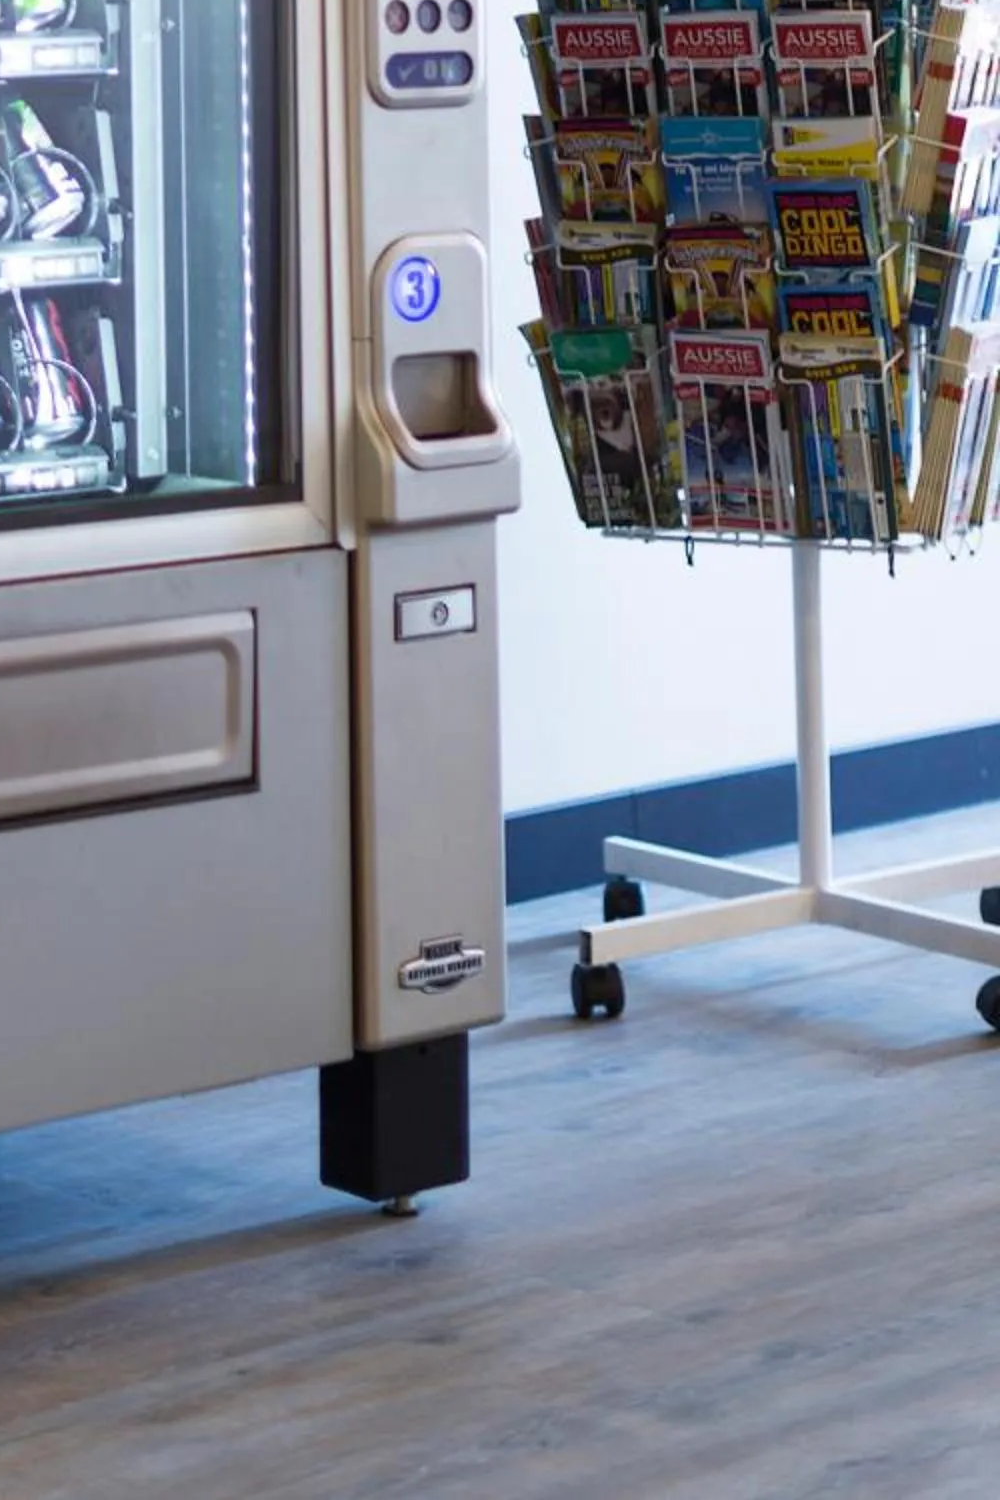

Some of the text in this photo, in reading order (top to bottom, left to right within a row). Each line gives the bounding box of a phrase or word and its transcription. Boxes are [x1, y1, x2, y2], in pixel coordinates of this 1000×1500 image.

[565, 28, 632, 48] AUSSIE
[673, 28, 745, 47] AUSSIE
[785, 28, 857, 47] AUSSIE
[422, 58, 458, 85] OK
[781, 208, 858, 236] COOL
[785, 232, 862, 257] DINGO
[407, 271, 424, 308] 3
[791, 309, 870, 337] COOL
[683, 345, 755, 366] AUSSIE
